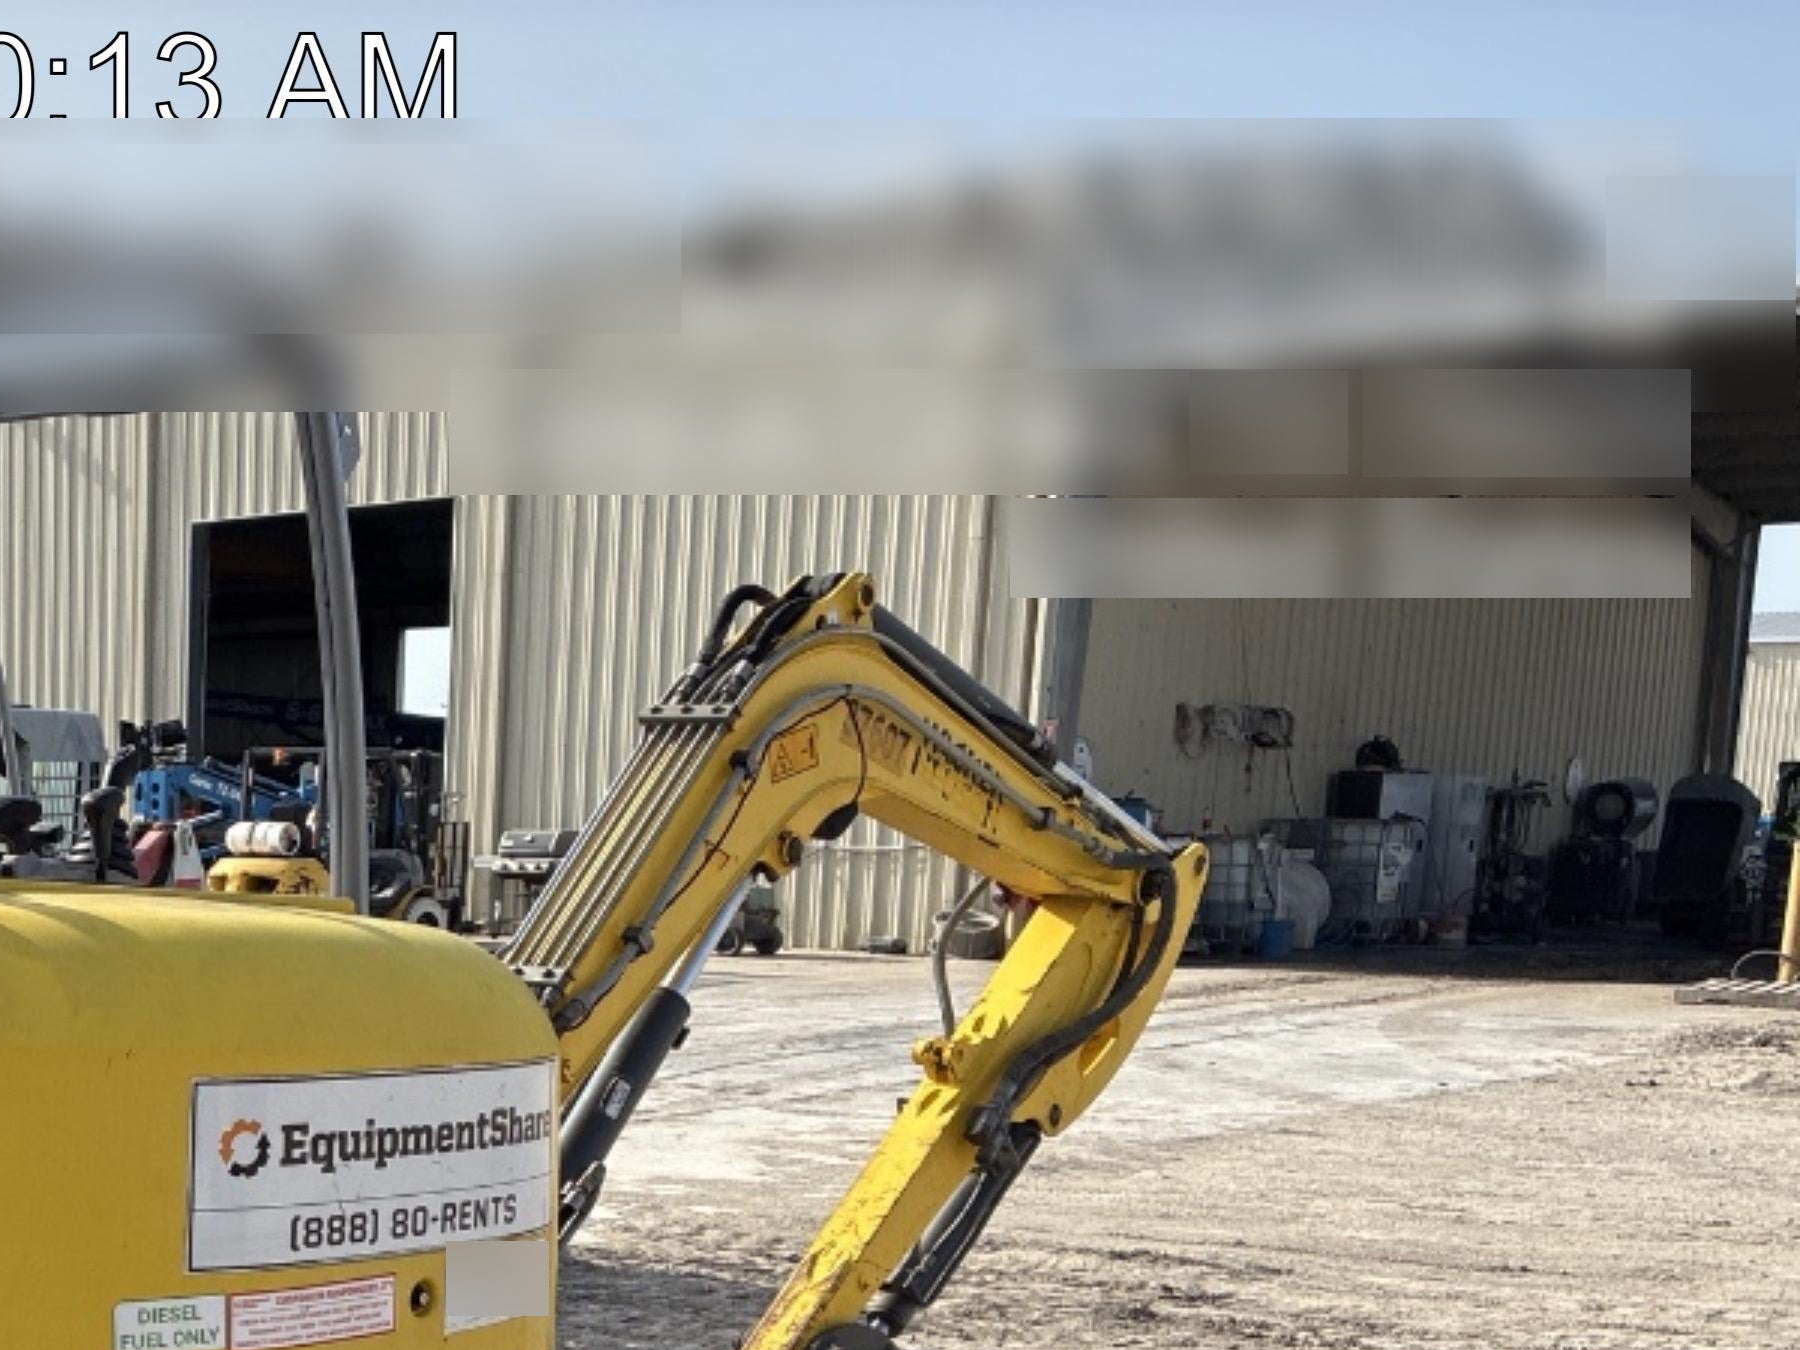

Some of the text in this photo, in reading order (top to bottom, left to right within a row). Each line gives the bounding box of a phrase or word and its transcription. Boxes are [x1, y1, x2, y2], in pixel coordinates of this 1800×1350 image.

[290, 1194, 517, 1251] (888) 80-RENTS
[137, 1303, 202, 1325] DIESEL
[119, 1325, 220, 1350] FUEL ONLY
